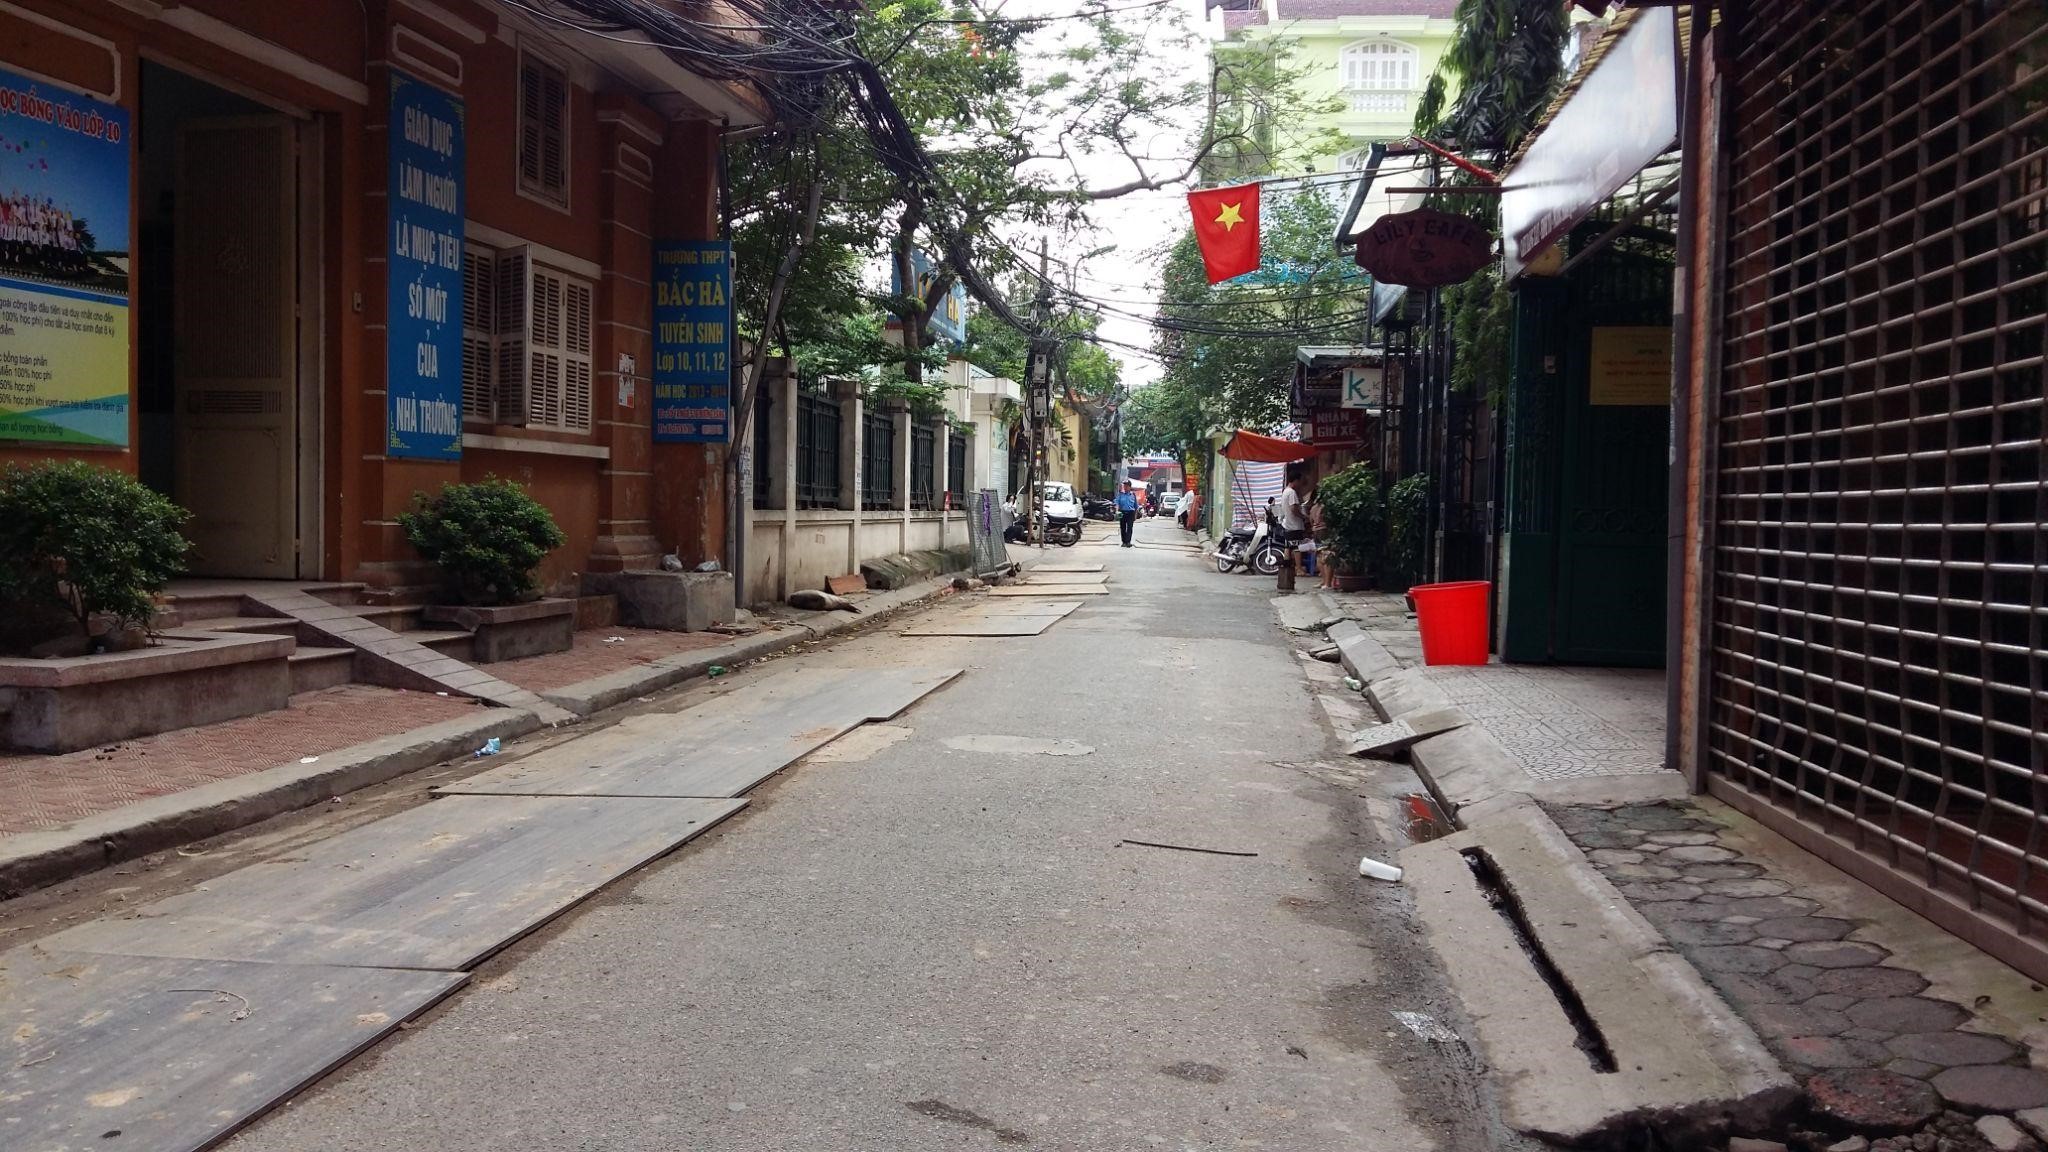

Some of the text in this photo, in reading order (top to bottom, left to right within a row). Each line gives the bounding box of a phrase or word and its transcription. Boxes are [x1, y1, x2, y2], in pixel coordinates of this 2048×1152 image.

[18, 85, 54, 124] BỔNG
[55, 100, 81, 132] VÀO
[82, 109, 104, 138] LỚP
[106, 120, 120, 143] 10
[404, 104, 453, 161] GIÁO DỤC
[400, 158, 457, 215] LÀM NGƯỜI
[396, 214, 460, 271] LÀ MỤC TIÊU
[1372, 219, 1477, 247] LILY CAFE
[701, 250, 726, 264] THPT
[408, 273, 448, 330] SỐ MỘT
[657, 267, 726, 306] BẮC HÀ
[659, 313, 724, 344] TUYỂN SINH
[14, 367, 31, 378] 100%
[417, 329, 438, 378] CỦA
[656, 350, 726, 373] Lớp 10, 11, 12
[396, 391, 457, 436] NHÀ TRƯỜNG
